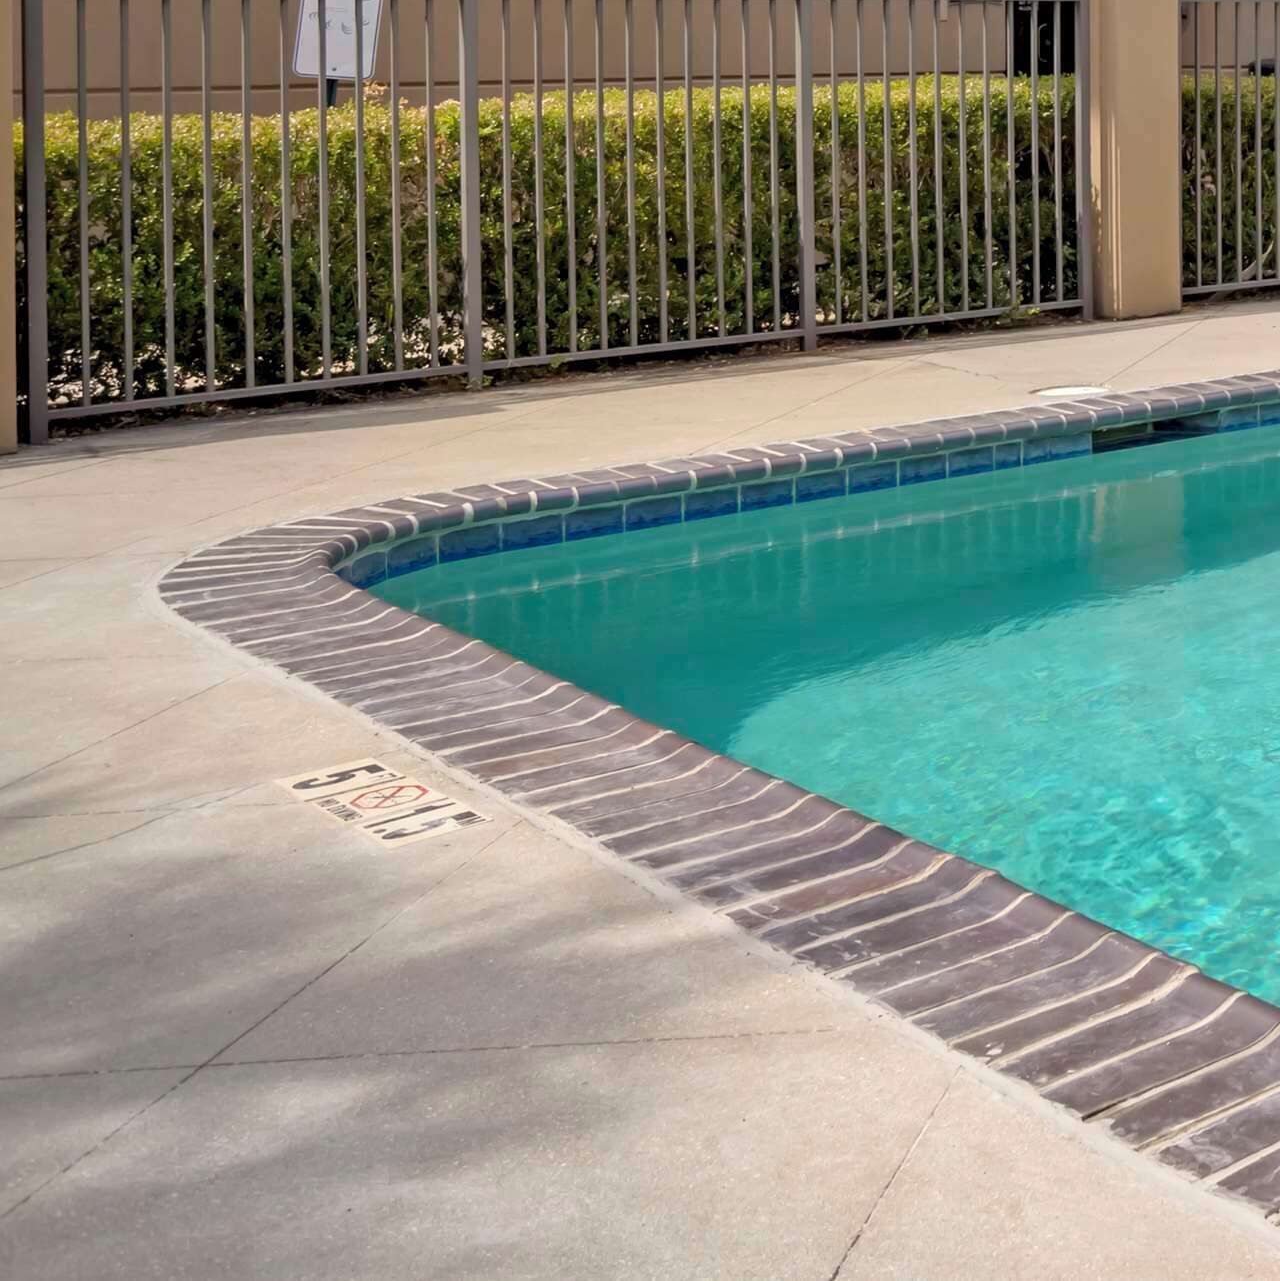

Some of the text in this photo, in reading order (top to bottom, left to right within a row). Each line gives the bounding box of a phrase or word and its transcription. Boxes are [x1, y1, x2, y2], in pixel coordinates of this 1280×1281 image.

[292, 764, 387, 790] 5
[326, 804, 363, 822] DIVING
[363, 802, 478, 840] 1.5
